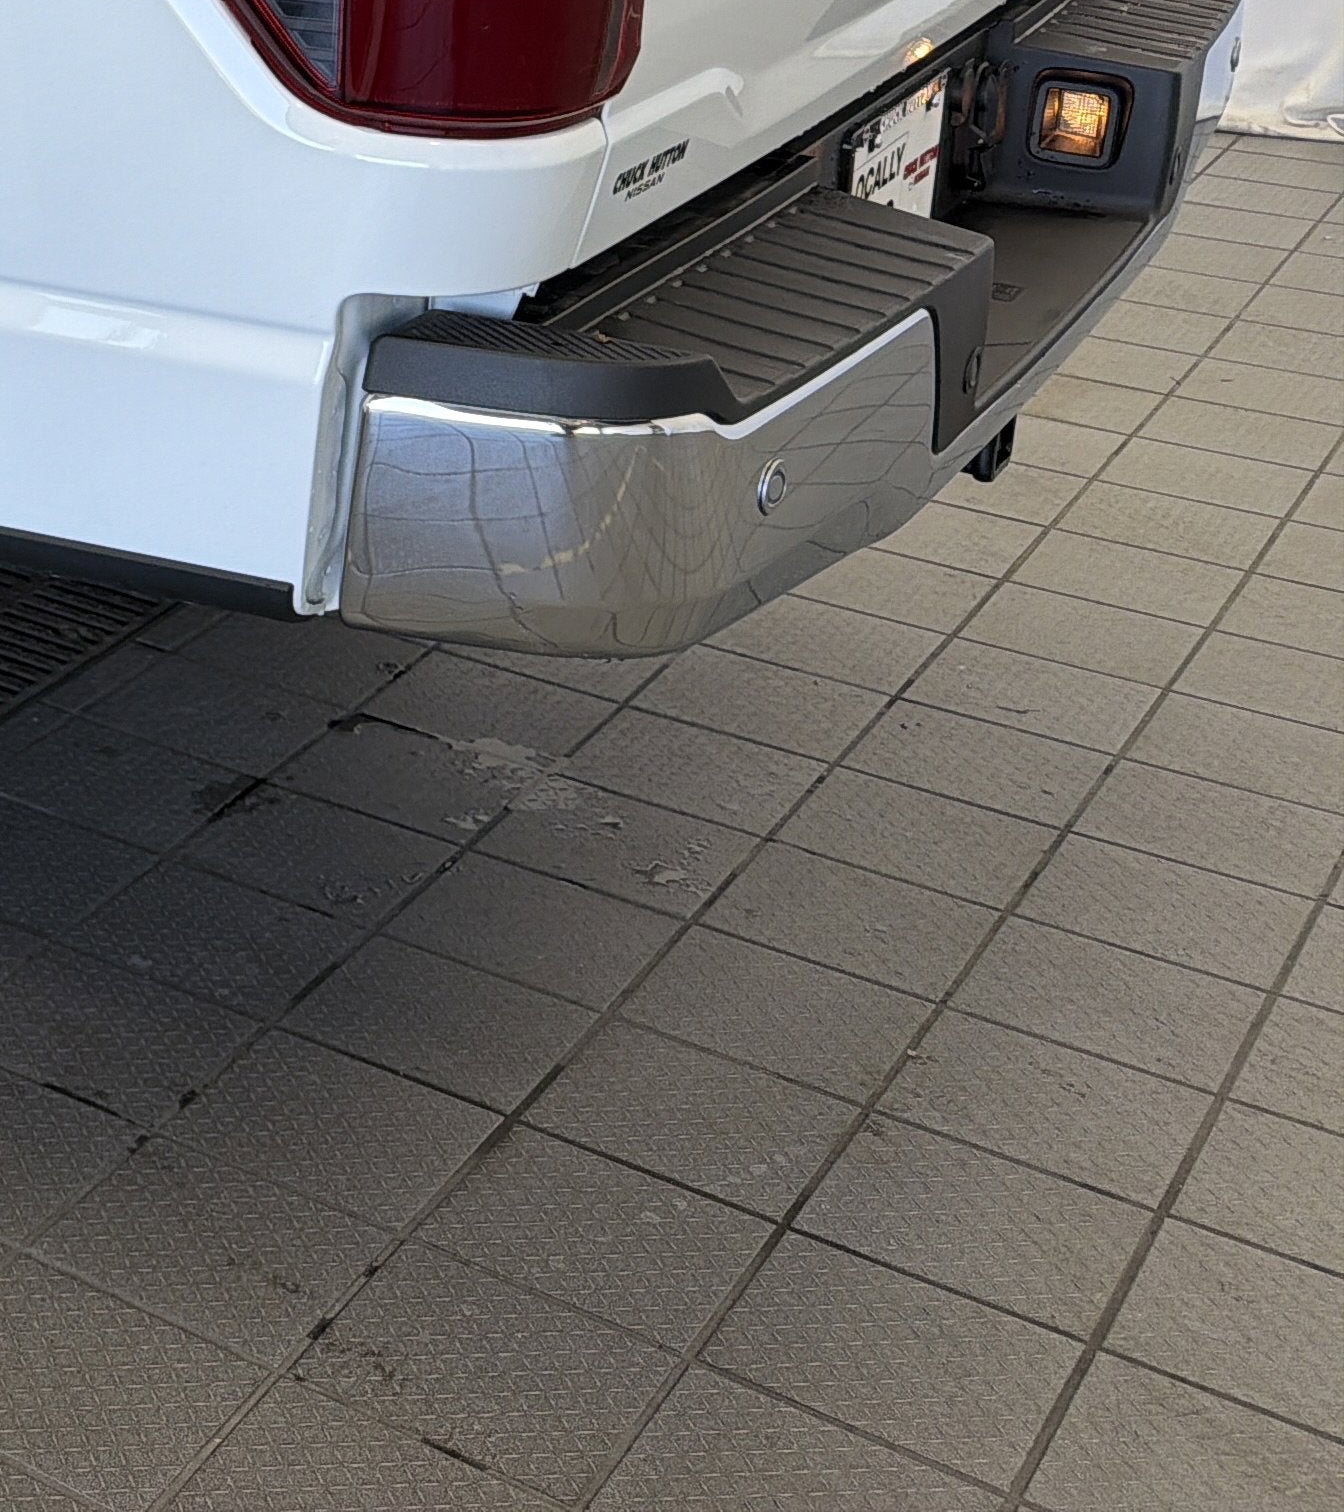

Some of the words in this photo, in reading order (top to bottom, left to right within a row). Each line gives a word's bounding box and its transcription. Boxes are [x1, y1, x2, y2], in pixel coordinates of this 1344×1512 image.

[613, 158, 650, 196] CHUCK
[647, 138, 690, 178] HUTTON
[624, 171, 665, 202] NISSAN
